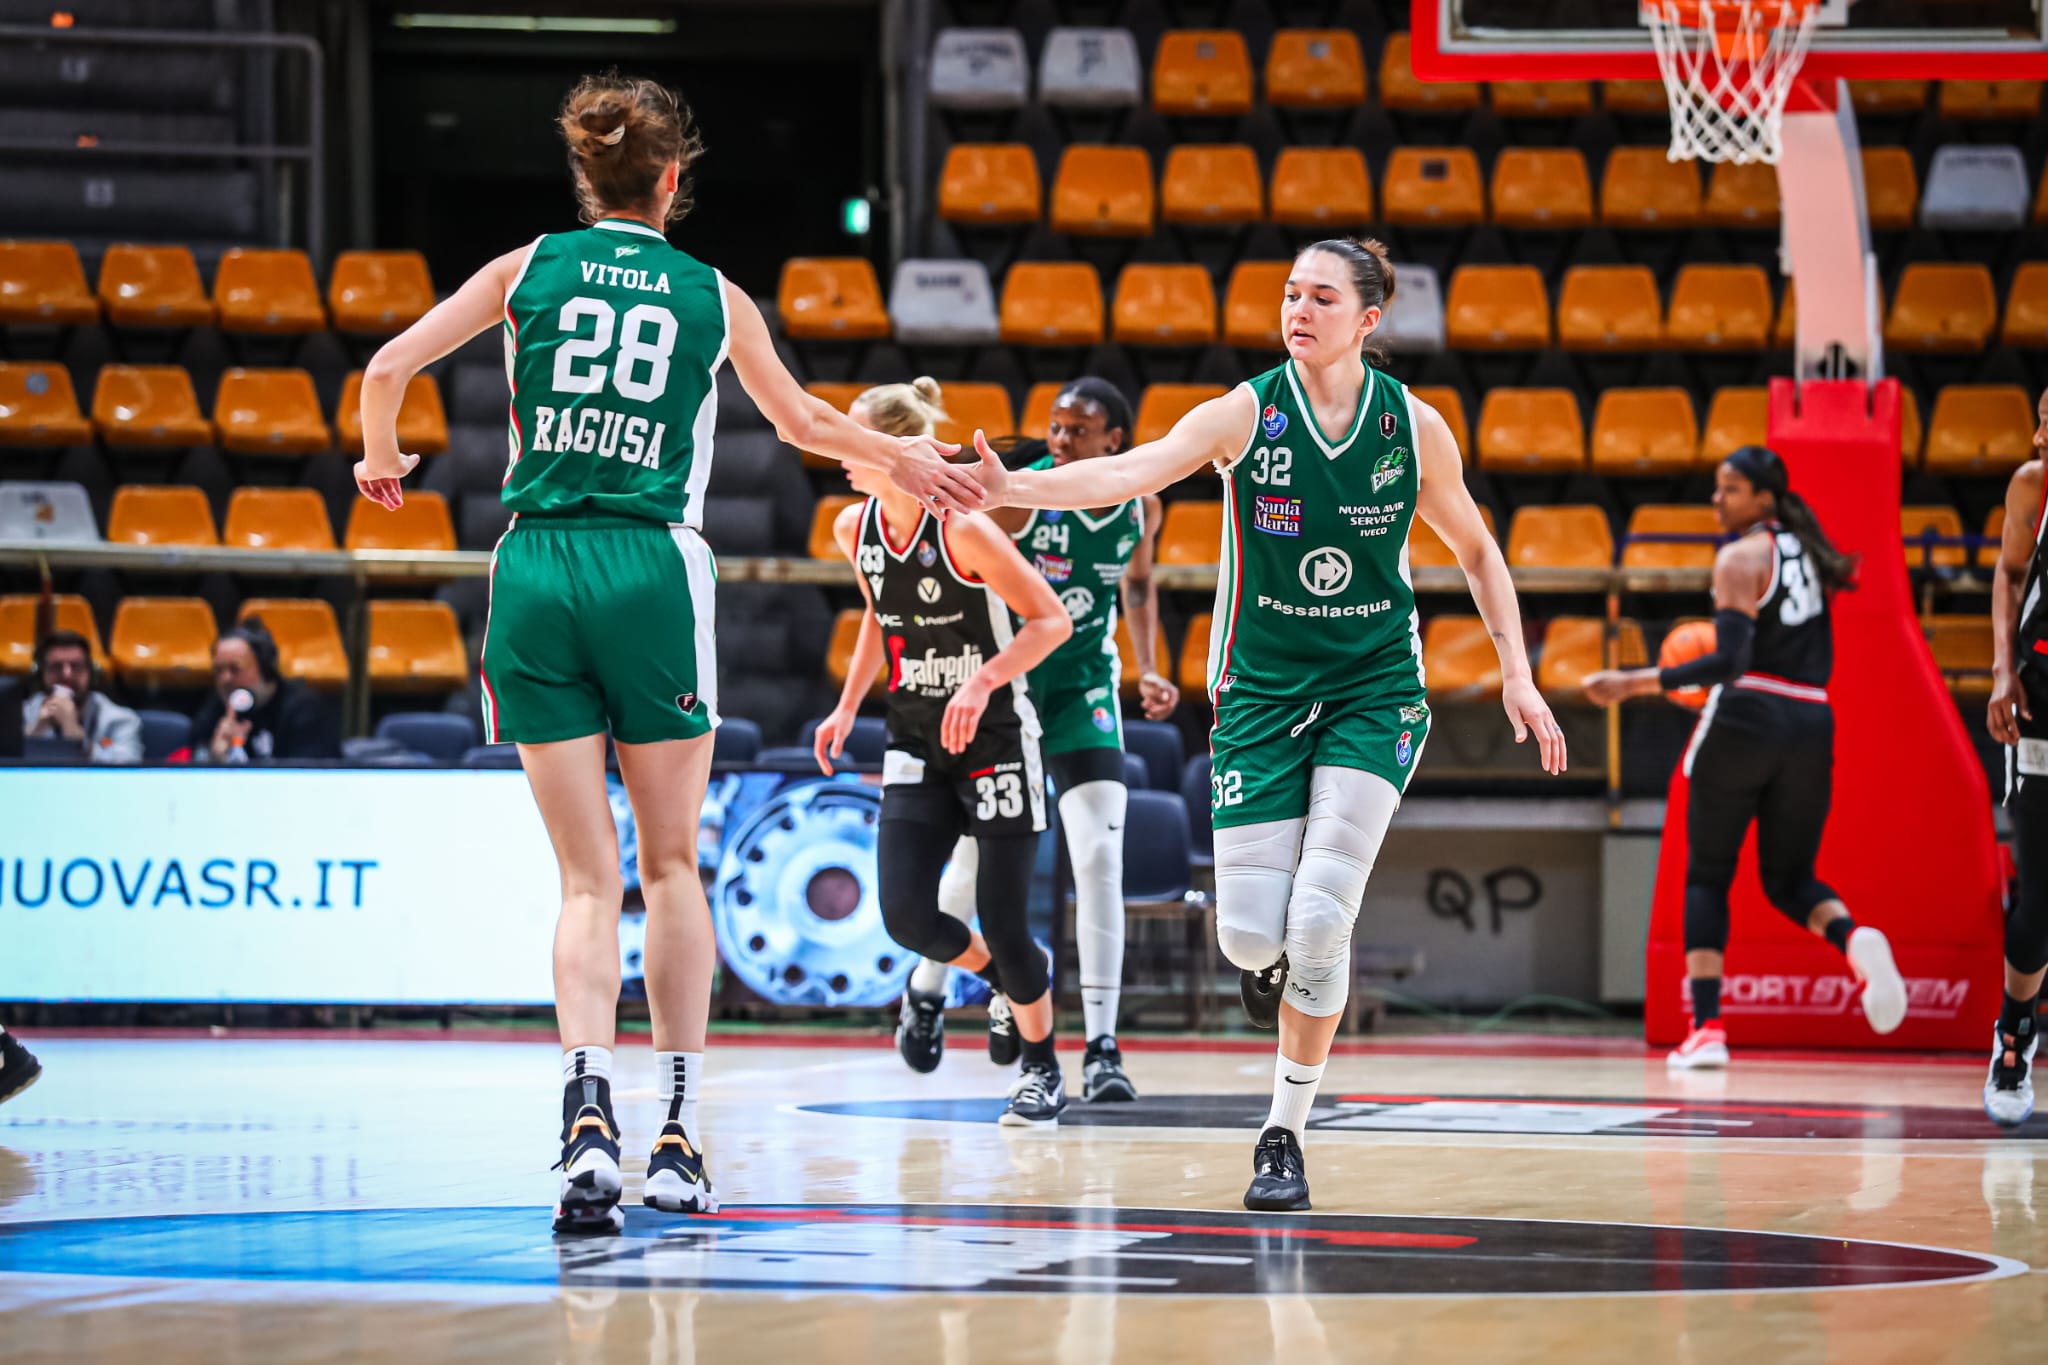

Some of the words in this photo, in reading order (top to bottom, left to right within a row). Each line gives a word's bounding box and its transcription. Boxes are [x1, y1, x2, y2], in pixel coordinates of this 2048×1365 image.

[581, 261, 671, 294] VITOLA
[552, 296, 679, 403] 28
[532, 406, 666, 470] RAGUSA
[1251, 446, 1293, 487] 32
[1256, 495, 1300, 516] Santa
[1338, 505, 1380, 515] NUOVA
[1382, 501, 1405, 513] AVIR
[1350, 513, 1397, 526] SERVICE
[1254, 510, 1299, 532] Maria
[1360, 526, 1388, 537] IVECO
[1032, 524, 1069, 554] 24
[862, 544, 886, 574] 33
[1258, 594, 1392, 619] Passalacqua
[975, 772, 1024, 822] 33
[1212, 769, 1244, 810] 32
[0, 858, 379, 908] UOVASR.IT
